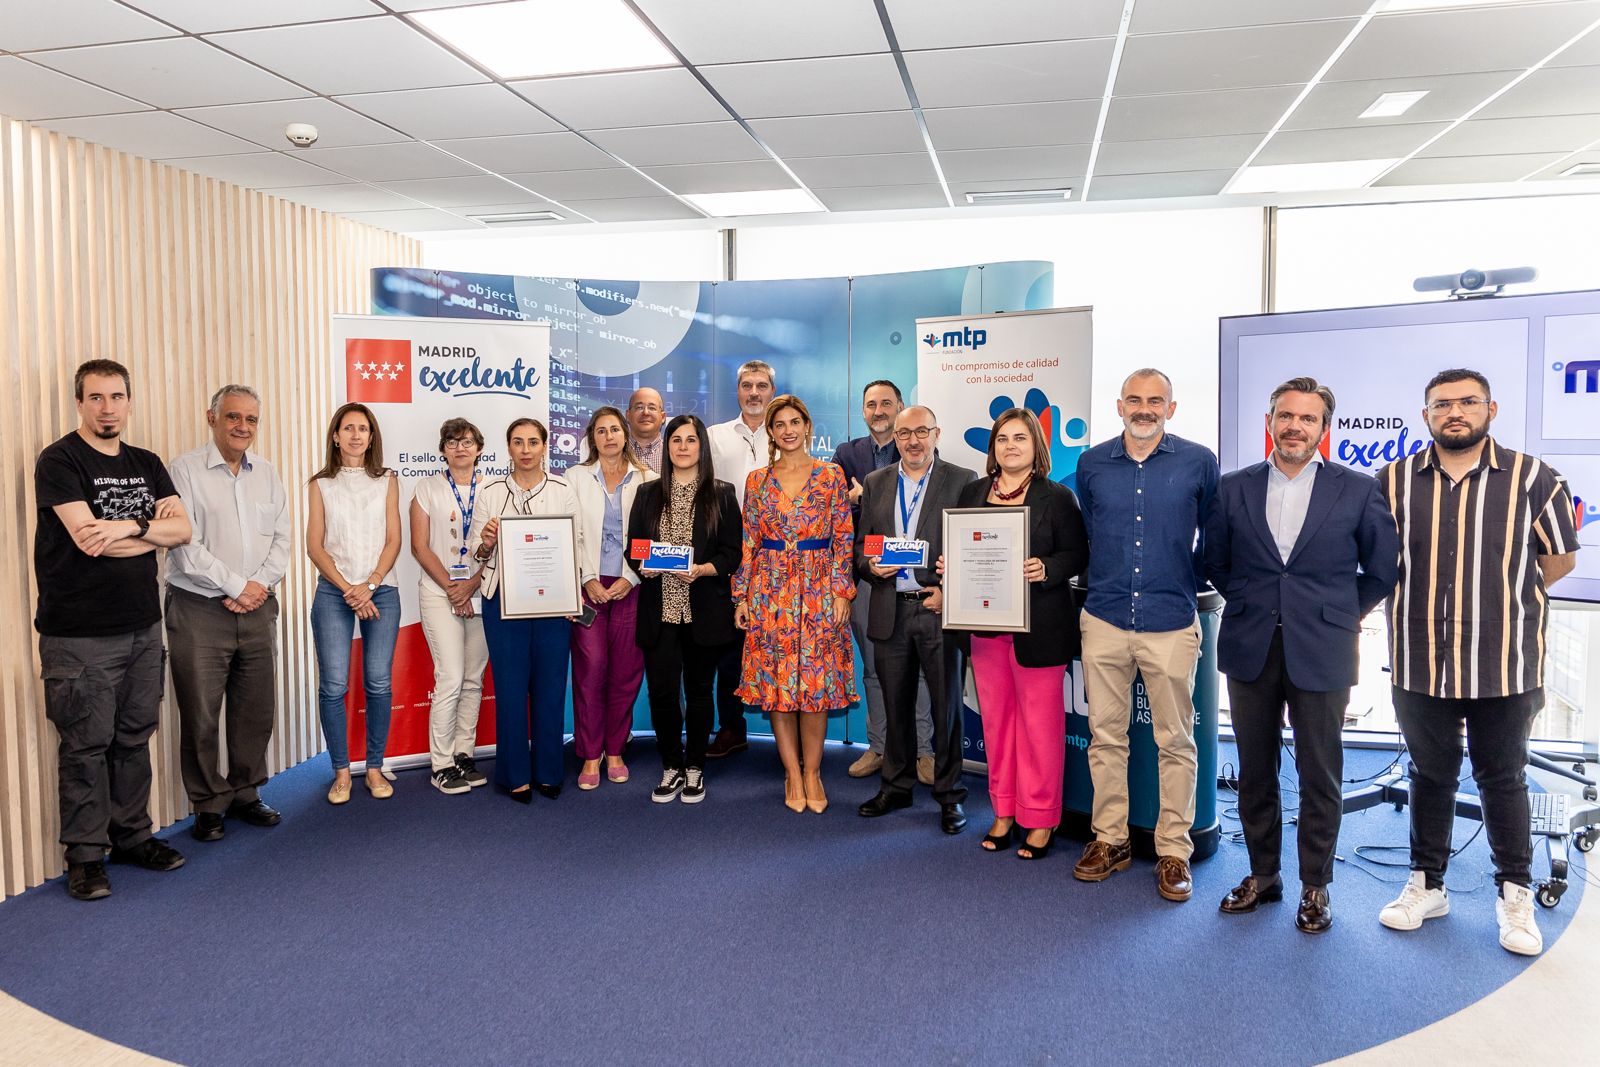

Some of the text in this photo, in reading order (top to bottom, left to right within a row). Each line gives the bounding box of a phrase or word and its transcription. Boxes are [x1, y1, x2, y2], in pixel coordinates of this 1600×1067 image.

[467, 283, 515, 304] object
[523, 296, 538, 309] to
[545, 303, 607, 325] mirror_ob
[599, 330, 657, 350] mirror_ob
[943, 326, 987, 350] mtp
[418, 345, 477, 358] MADRID
[941, 357, 1059, 373] Un compromiso de calidad
[419, 356, 540, 393] excelente
[966, 373, 1034, 384] con la sociedad
[1338, 417, 1404, 429] MADRID
[399, 452, 408, 463] El
[412, 453, 436, 463] sello
[94, 477, 120, 486] HISTORY
[120, 478, 128, 486] OF
